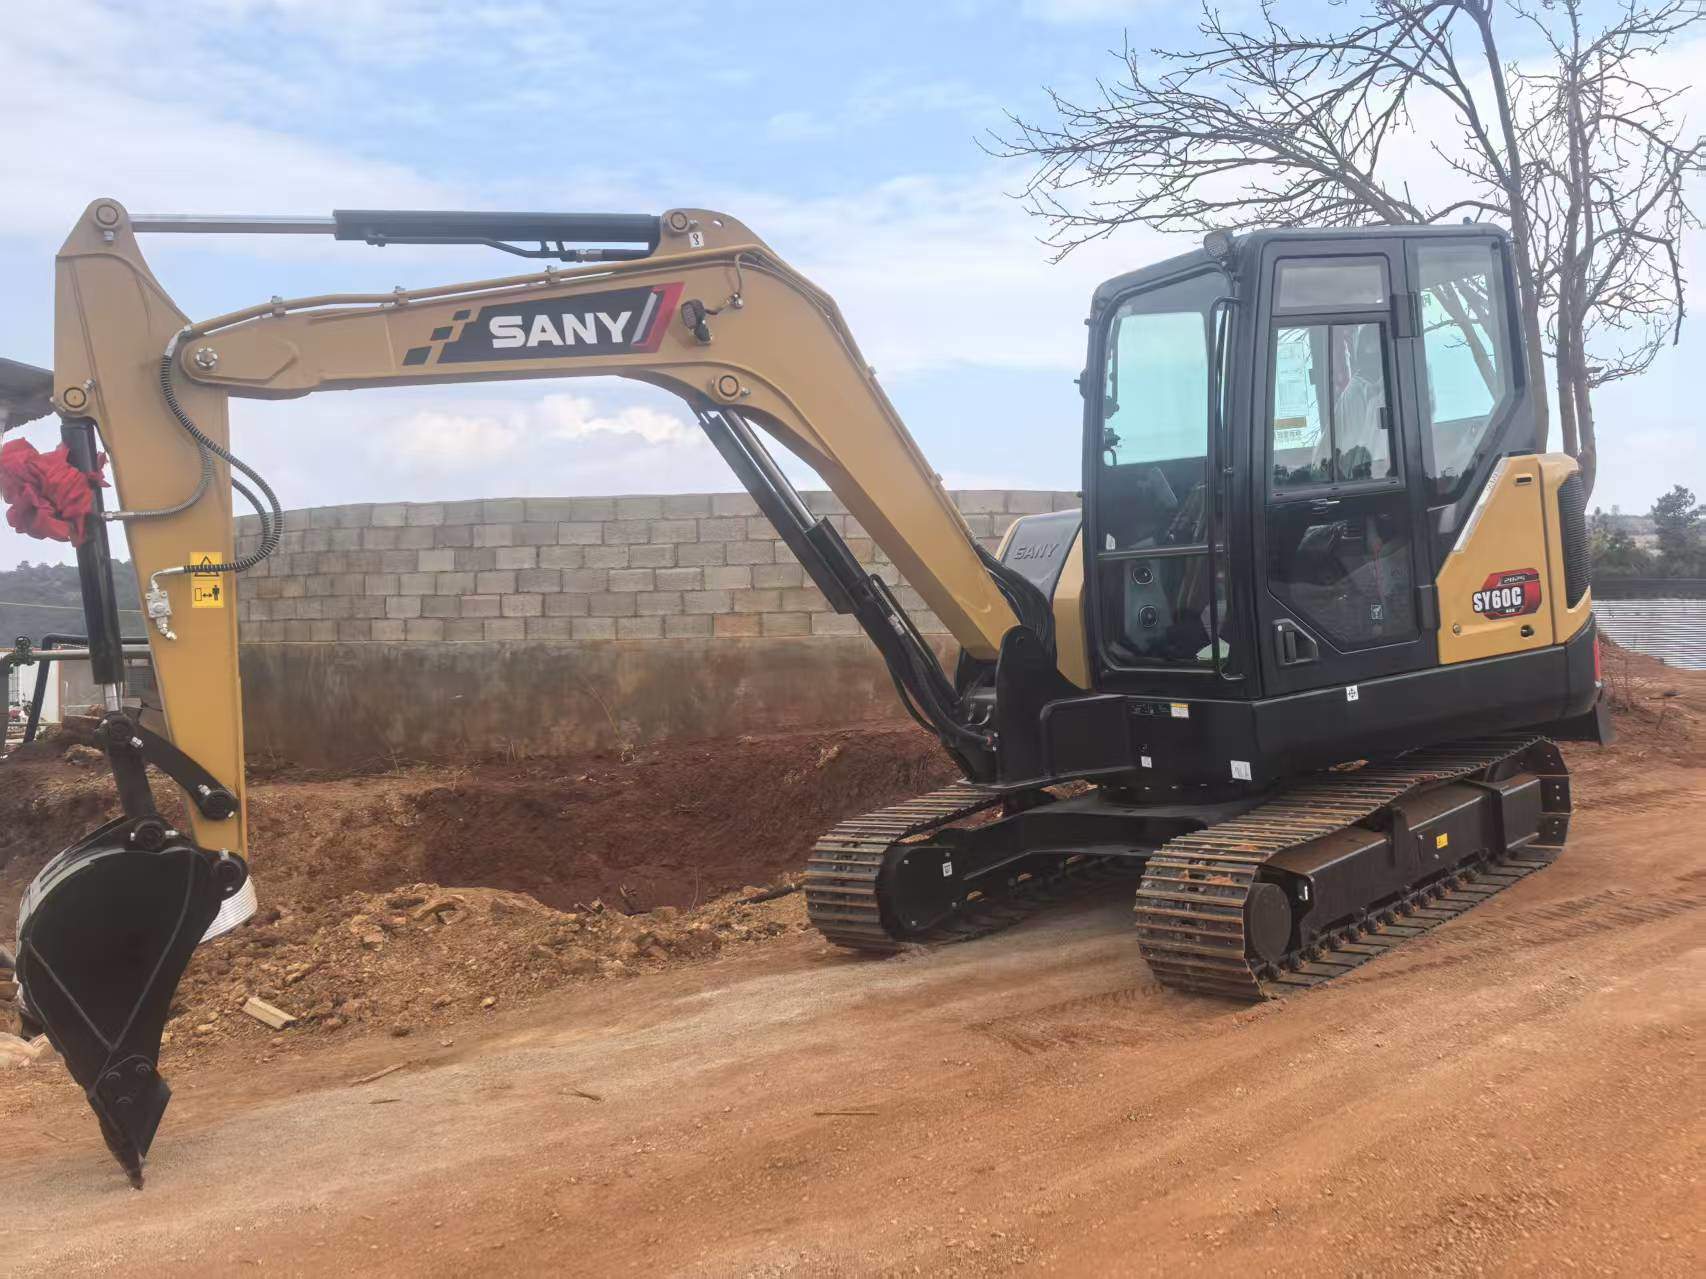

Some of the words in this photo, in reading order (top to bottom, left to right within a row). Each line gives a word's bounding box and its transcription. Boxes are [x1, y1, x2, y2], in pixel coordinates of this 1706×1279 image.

[489, 311, 633, 348] SANY
[1013, 544, 1060, 560] SANY
[1473, 587, 1522, 612] SY60C
